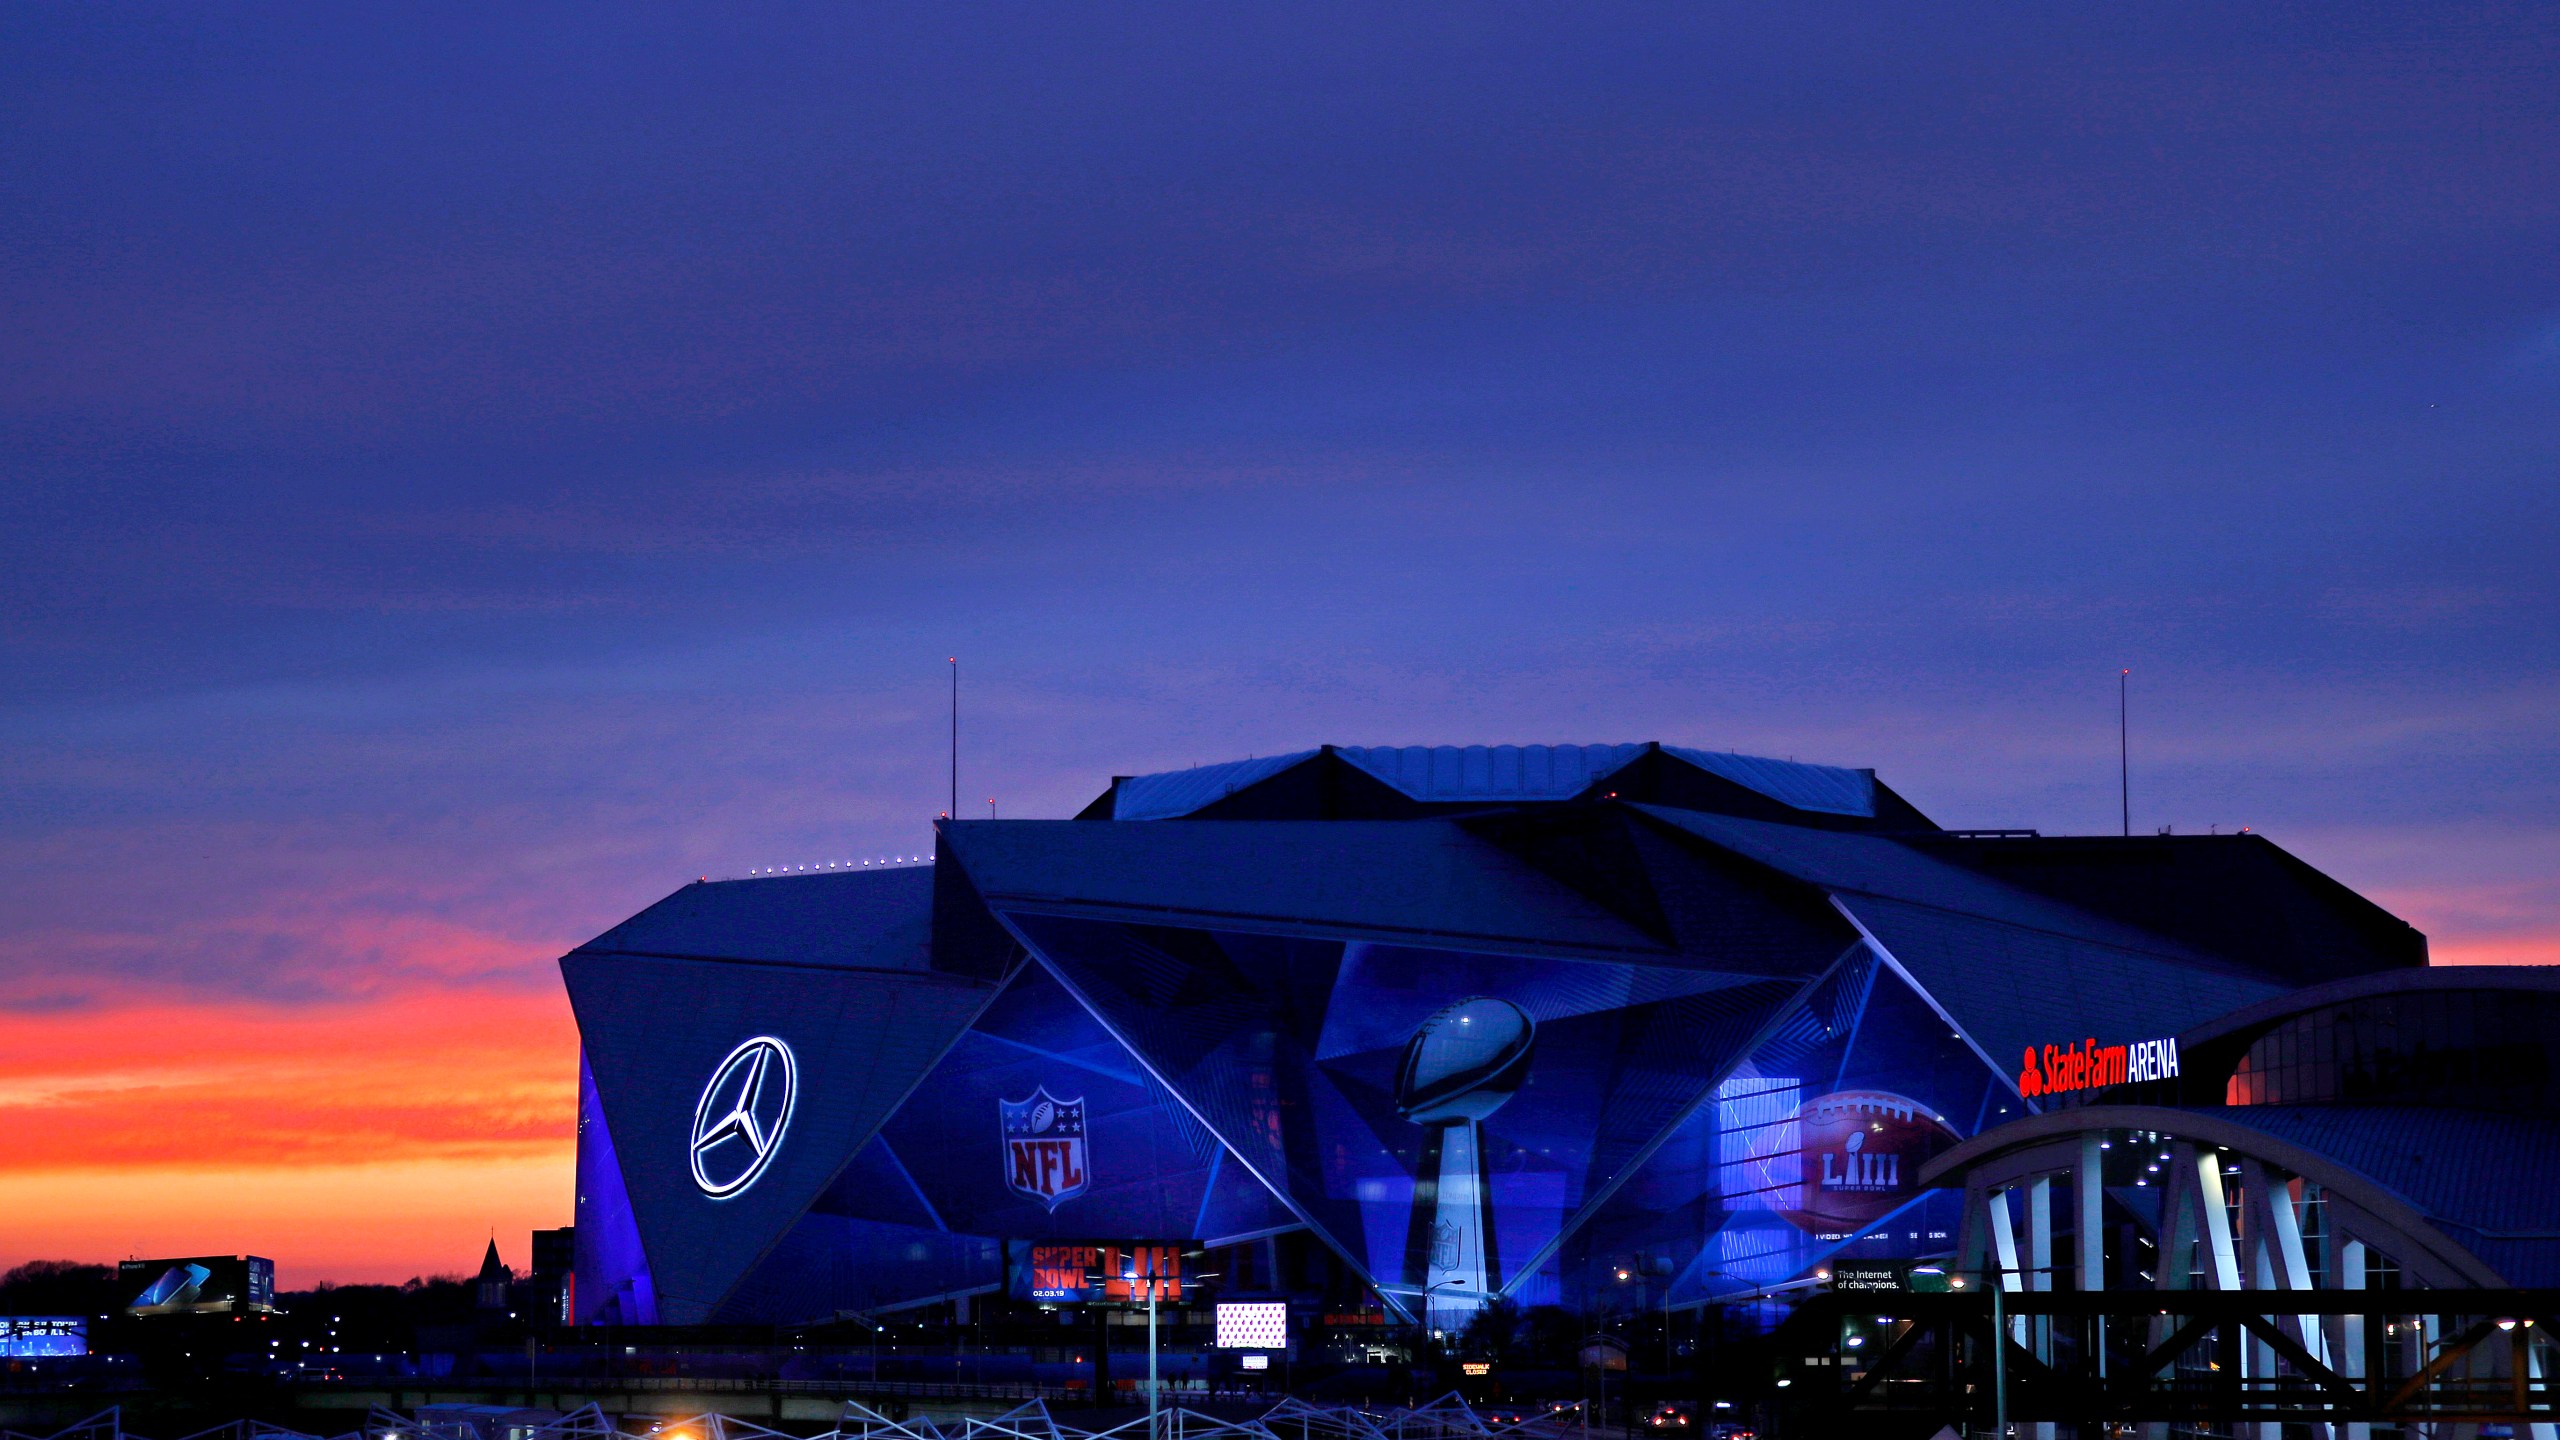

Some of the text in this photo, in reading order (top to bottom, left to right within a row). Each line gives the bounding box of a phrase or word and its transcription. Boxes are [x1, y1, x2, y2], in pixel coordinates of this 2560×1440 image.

[2128, 1037, 2179, 1083] ARENA
[1012, 1141, 1081, 1196] NFL
[1033, 1246, 1097, 1267] SUPER
[1033, 1268, 1090, 1289] BOWL
[1837, 1280, 1847, 1289] of
[1838, 1270, 1892, 1279] The Internet
